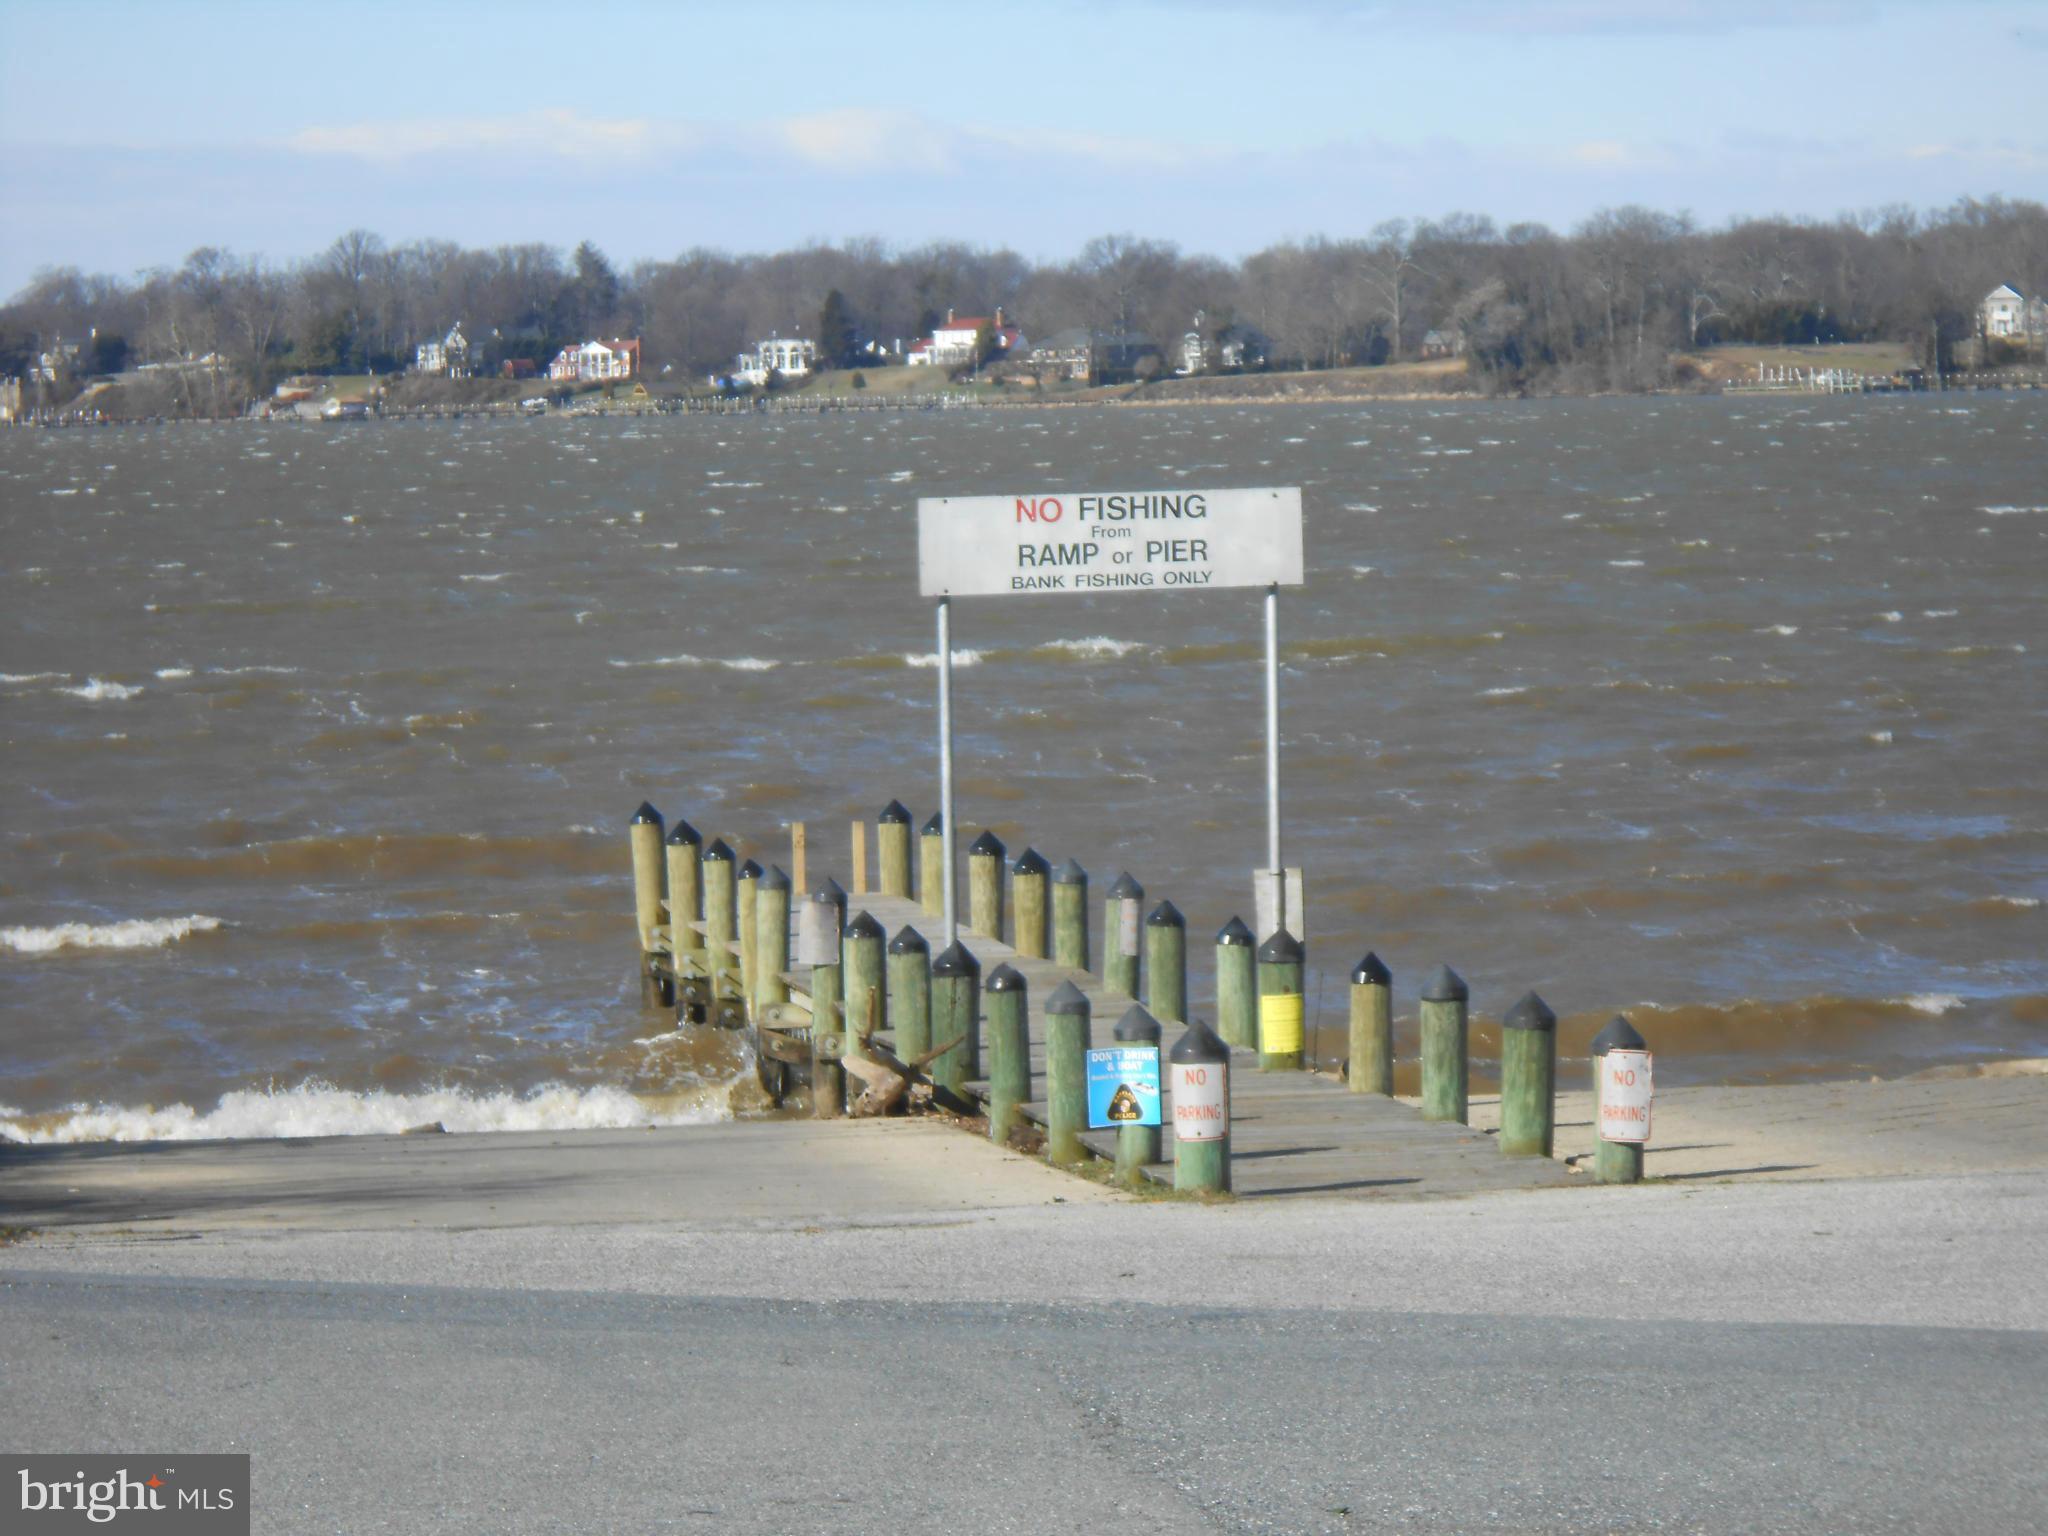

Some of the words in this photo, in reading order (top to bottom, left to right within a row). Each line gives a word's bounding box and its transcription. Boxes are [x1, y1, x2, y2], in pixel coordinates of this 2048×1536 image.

[1016, 497, 1063, 522] NO
[1079, 494, 1207, 521] FISHING
[1091, 525, 1131, 538] From
[1018, 543, 1100, 567] RAMP
[1112, 550, 1133, 563] or
[1146, 540, 1208, 562] PIER
[1012, 576, 1065, 590] BANK
[1075, 573, 1155, 588] FISHING
[1163, 571, 1213, 585] ONLY
[1091, 1052, 1121, 1062] DON'T
[1124, 1051, 1155, 1061] DRINK
[1185, 1069, 1207, 1086] NO
[1613, 1070, 1635, 1087] NO
[1177, 1104, 1220, 1120] PARKING
[1603, 1105, 1646, 1122] PARKING
